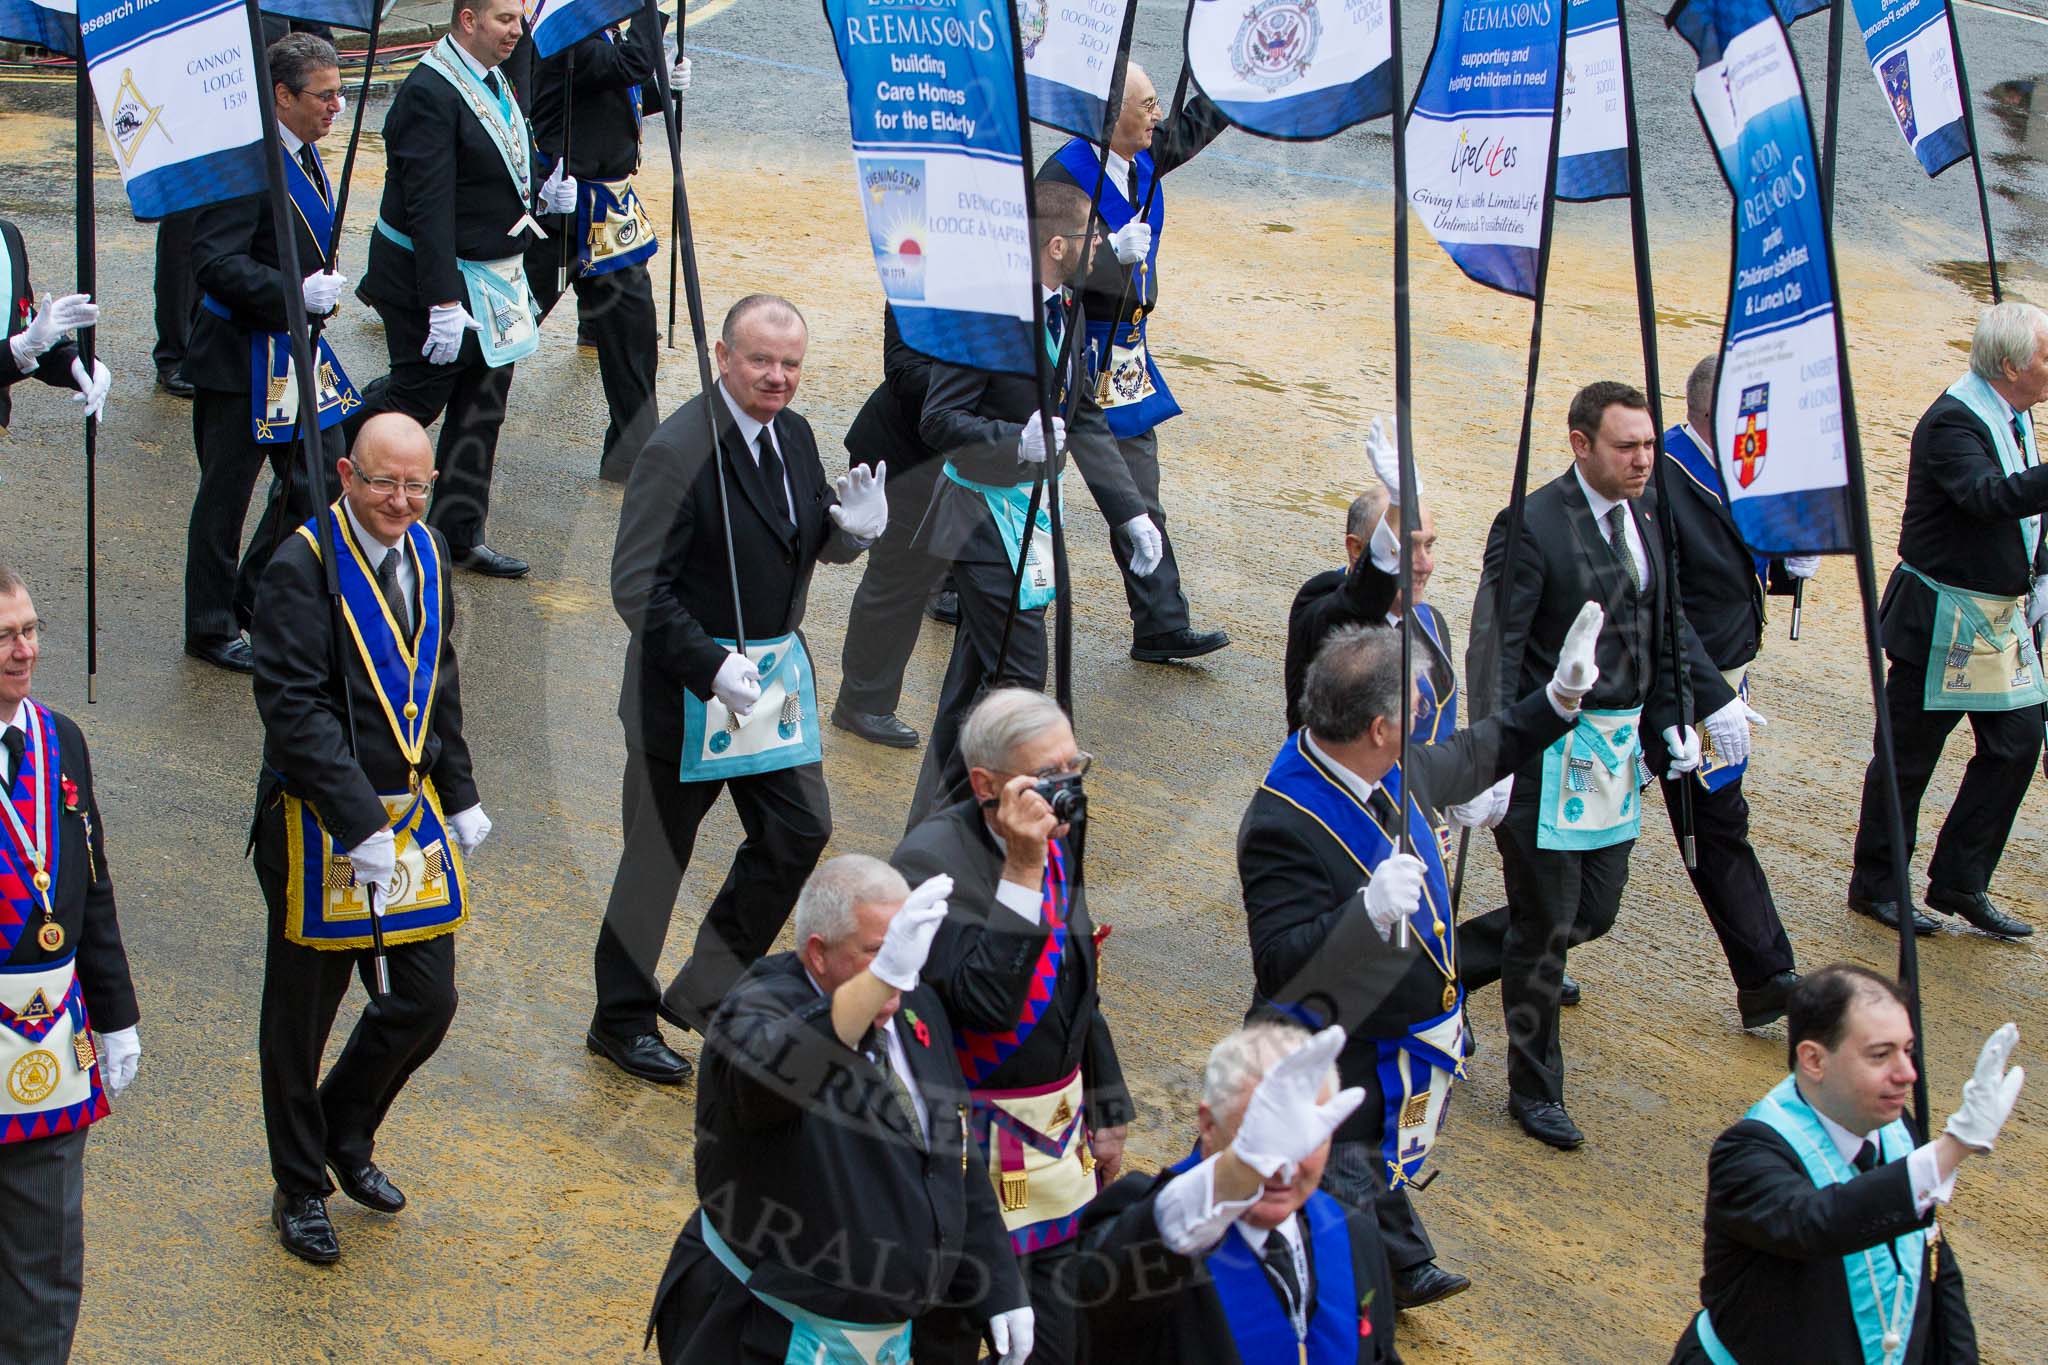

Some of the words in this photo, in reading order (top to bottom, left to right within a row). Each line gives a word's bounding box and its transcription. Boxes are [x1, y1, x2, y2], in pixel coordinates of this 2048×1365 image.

[80, 0, 133, 37] esearch
[186, 44, 241, 76] CANNON
[891, 53, 946, 79] building
[1461, 48, 1510, 68] supporting
[1511, 46, 1530, 62] and
[203, 67, 246, 94] LODGE
[1473, 72, 1511, 88] children
[1512, 70, 1521, 85] in
[1523, 69, 1547, 85] need
[877, 81, 915, 101] Care
[875, 110, 899, 129] for
[902, 110, 928, 130] the
[1413, 188, 1452, 214] Giving
[1488, 192, 1520, 210] Limited
[1522, 193, 1538, 216] Life
[930, 216, 975, 235] LODGE
[1433, 215, 1479, 232] Unlimited
